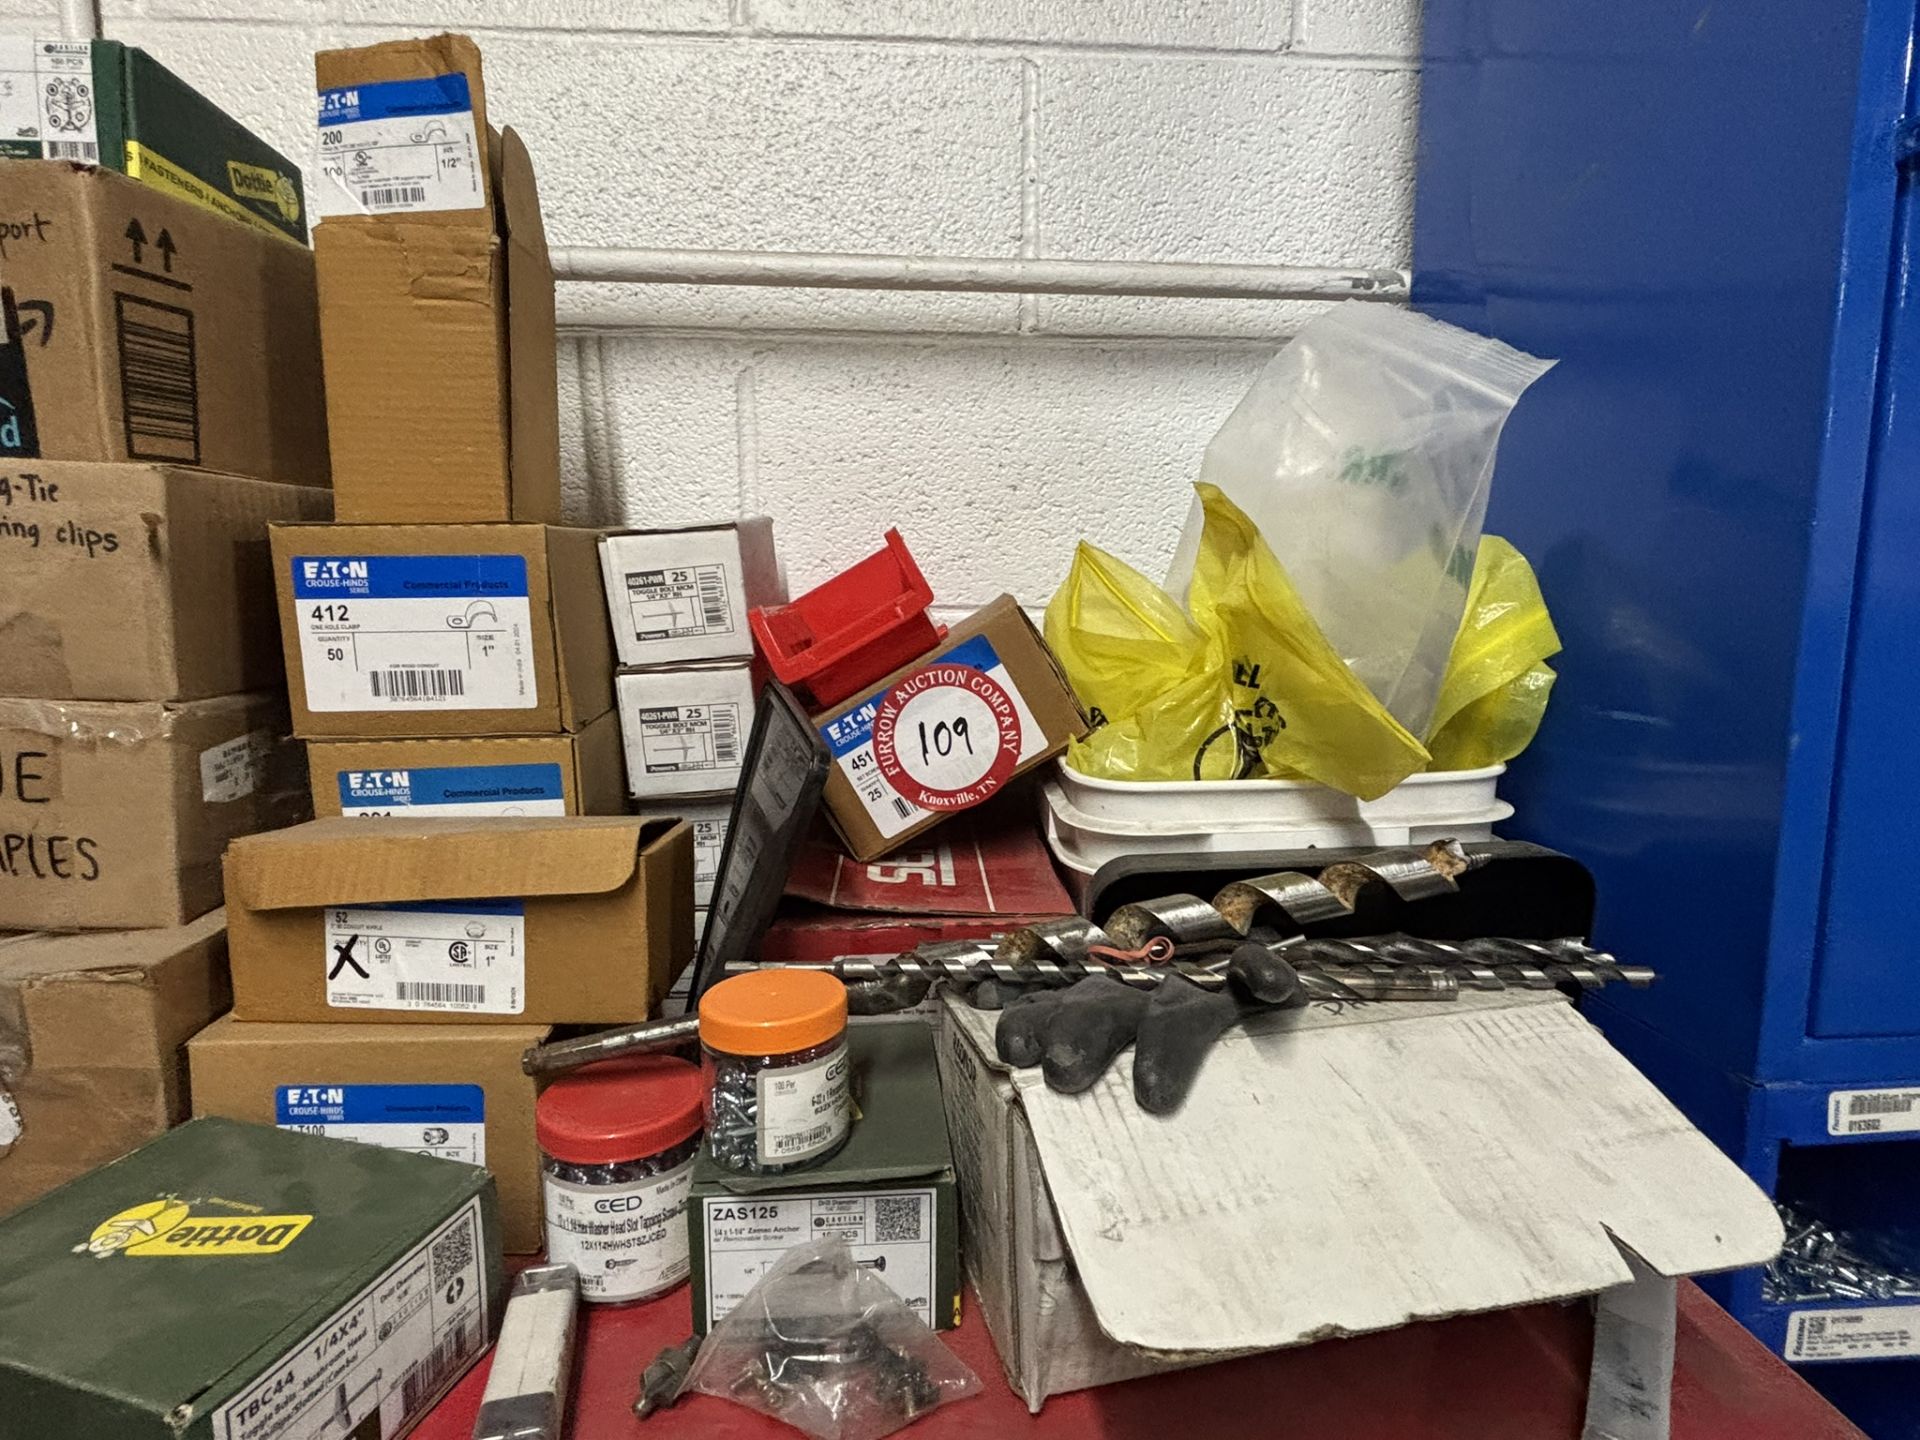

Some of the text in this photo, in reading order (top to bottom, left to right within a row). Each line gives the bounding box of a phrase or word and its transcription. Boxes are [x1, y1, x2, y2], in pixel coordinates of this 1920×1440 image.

[318, 90, 360, 111] EATON
[322, 130, 343, 146] 200
[143, 156, 204, 200] FASTENERS
[232, 167, 274, 193] Dottie
[56, 520, 119, 559] clips
[303, 561, 368, 579] EATON
[671, 571, 688, 582] 25
[305, 579, 369, 588] CROUSE-HINDS
[632, 588, 657, 596] TOGGLE
[311, 604, 350, 622] 412
[327, 647, 344, 661] 50
[482, 645, 495, 657] 1"
[686, 708, 702, 719] 25
[827, 703, 877, 740] EATON
[877, 669, 1019, 777] FURROW AUCTION COMPANY
[835, 720, 875, 747] CROUSE-HIN
[918, 716, 974, 766] 109
[851, 750, 874, 771] 451
[348, 771, 410, 789] EATON
[350, 787, 411, 797] CROUSE-HINDS
[443, 785, 545, 799] Commercial Products
[867, 787, 882, 802] 25
[918, 776, 998, 806] Knoxville, TN
[697, 823, 712, 833] 25
[335, 911, 348, 924] 52
[825, 1057, 847, 1081] CE
[287, 1088, 343, 1105] EATON
[288, 1106, 344, 1116] CROUSE-HINDS
[594, 1195, 642, 1214] CED
[713, 1205, 778, 1221] ZAS125
[627, 1218, 639, 1233] Slot
[773, 1225, 799, 1233] Anchor
[165, 1224, 302, 1247] Dottie
[235, 1308, 366, 1426] TBC44 1/4X4"
